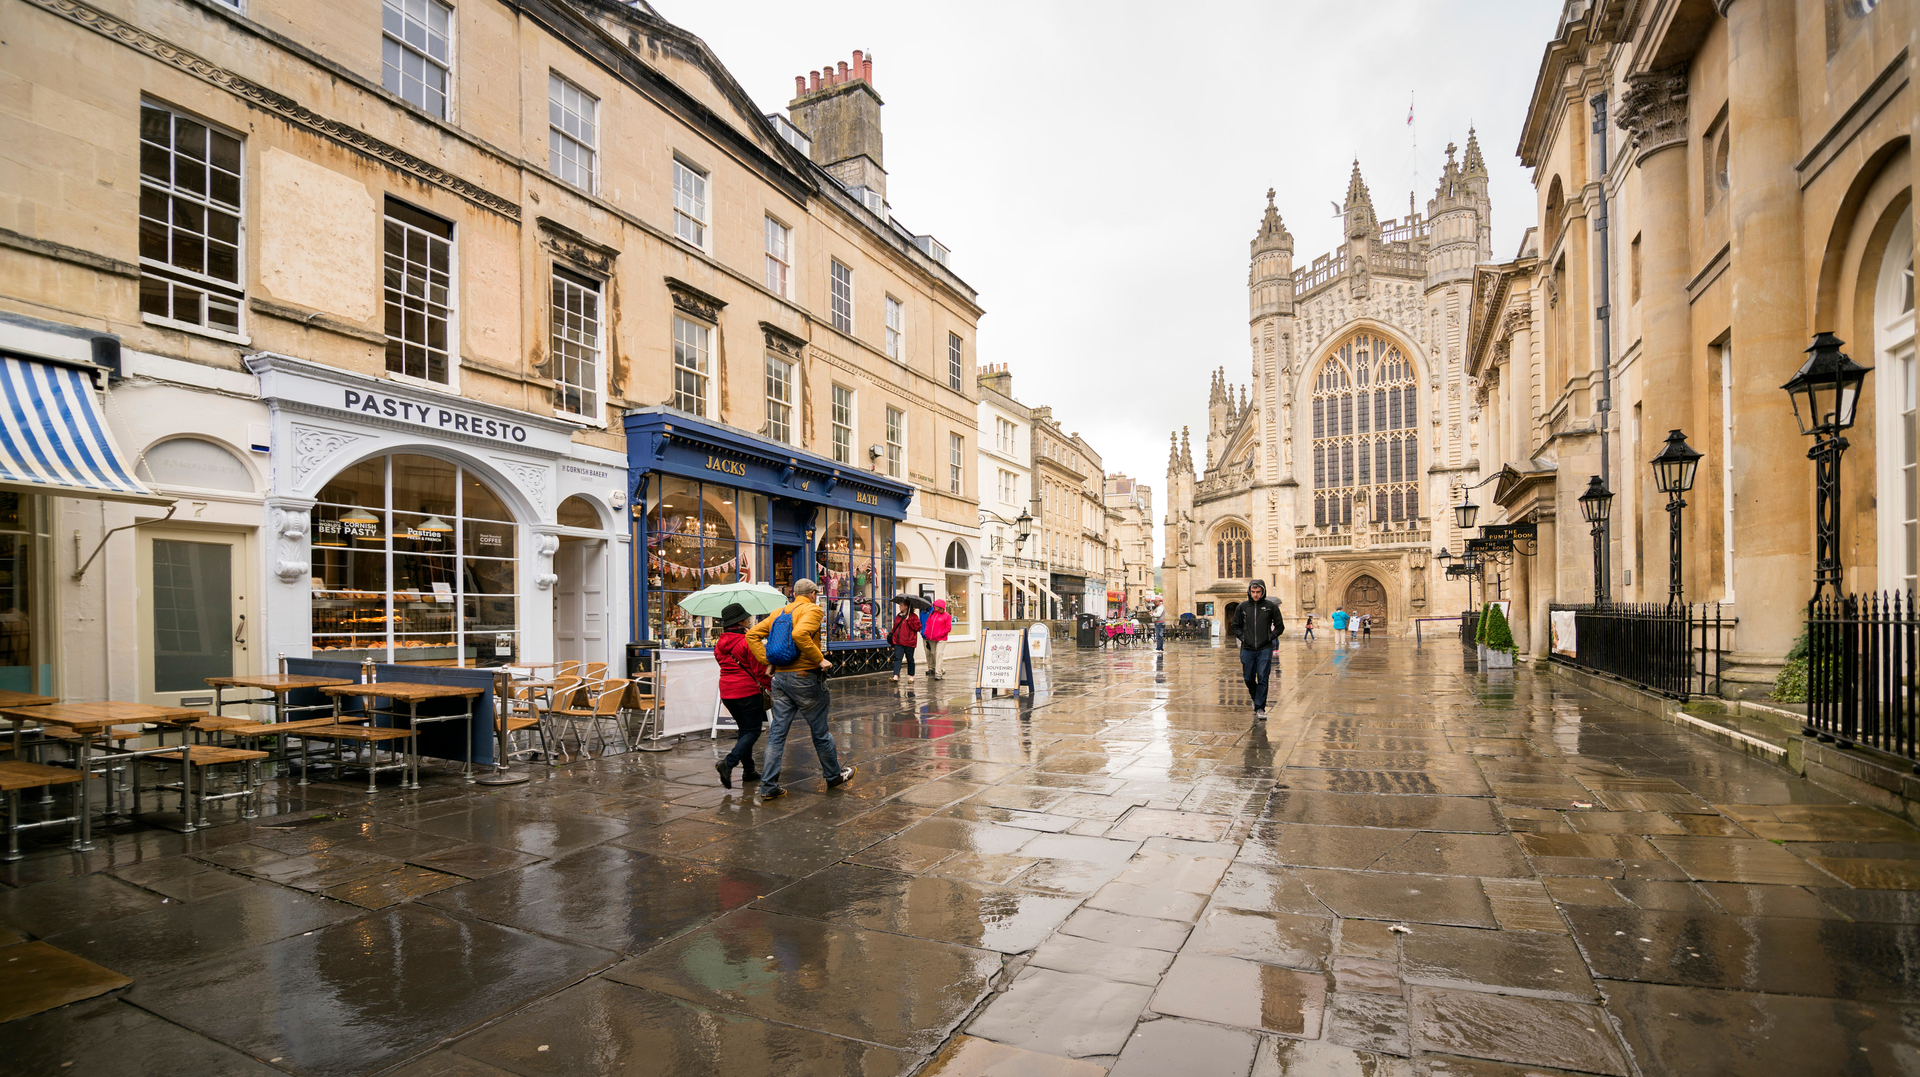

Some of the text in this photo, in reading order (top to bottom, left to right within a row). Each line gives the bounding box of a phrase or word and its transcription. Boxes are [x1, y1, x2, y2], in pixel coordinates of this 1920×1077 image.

[344, 389, 527, 443] PASTY PRESTO
[566, 466, 589, 475] CORNISH
[590, 470, 608, 478] BAKERY
[705, 455, 878, 506] JACKS of BATH
[192, 502, 208, 518] 7
[343, 521, 377, 530] CORNISH
[344, 527, 377, 537] PASTY
[407, 527, 442, 538] Pastries
